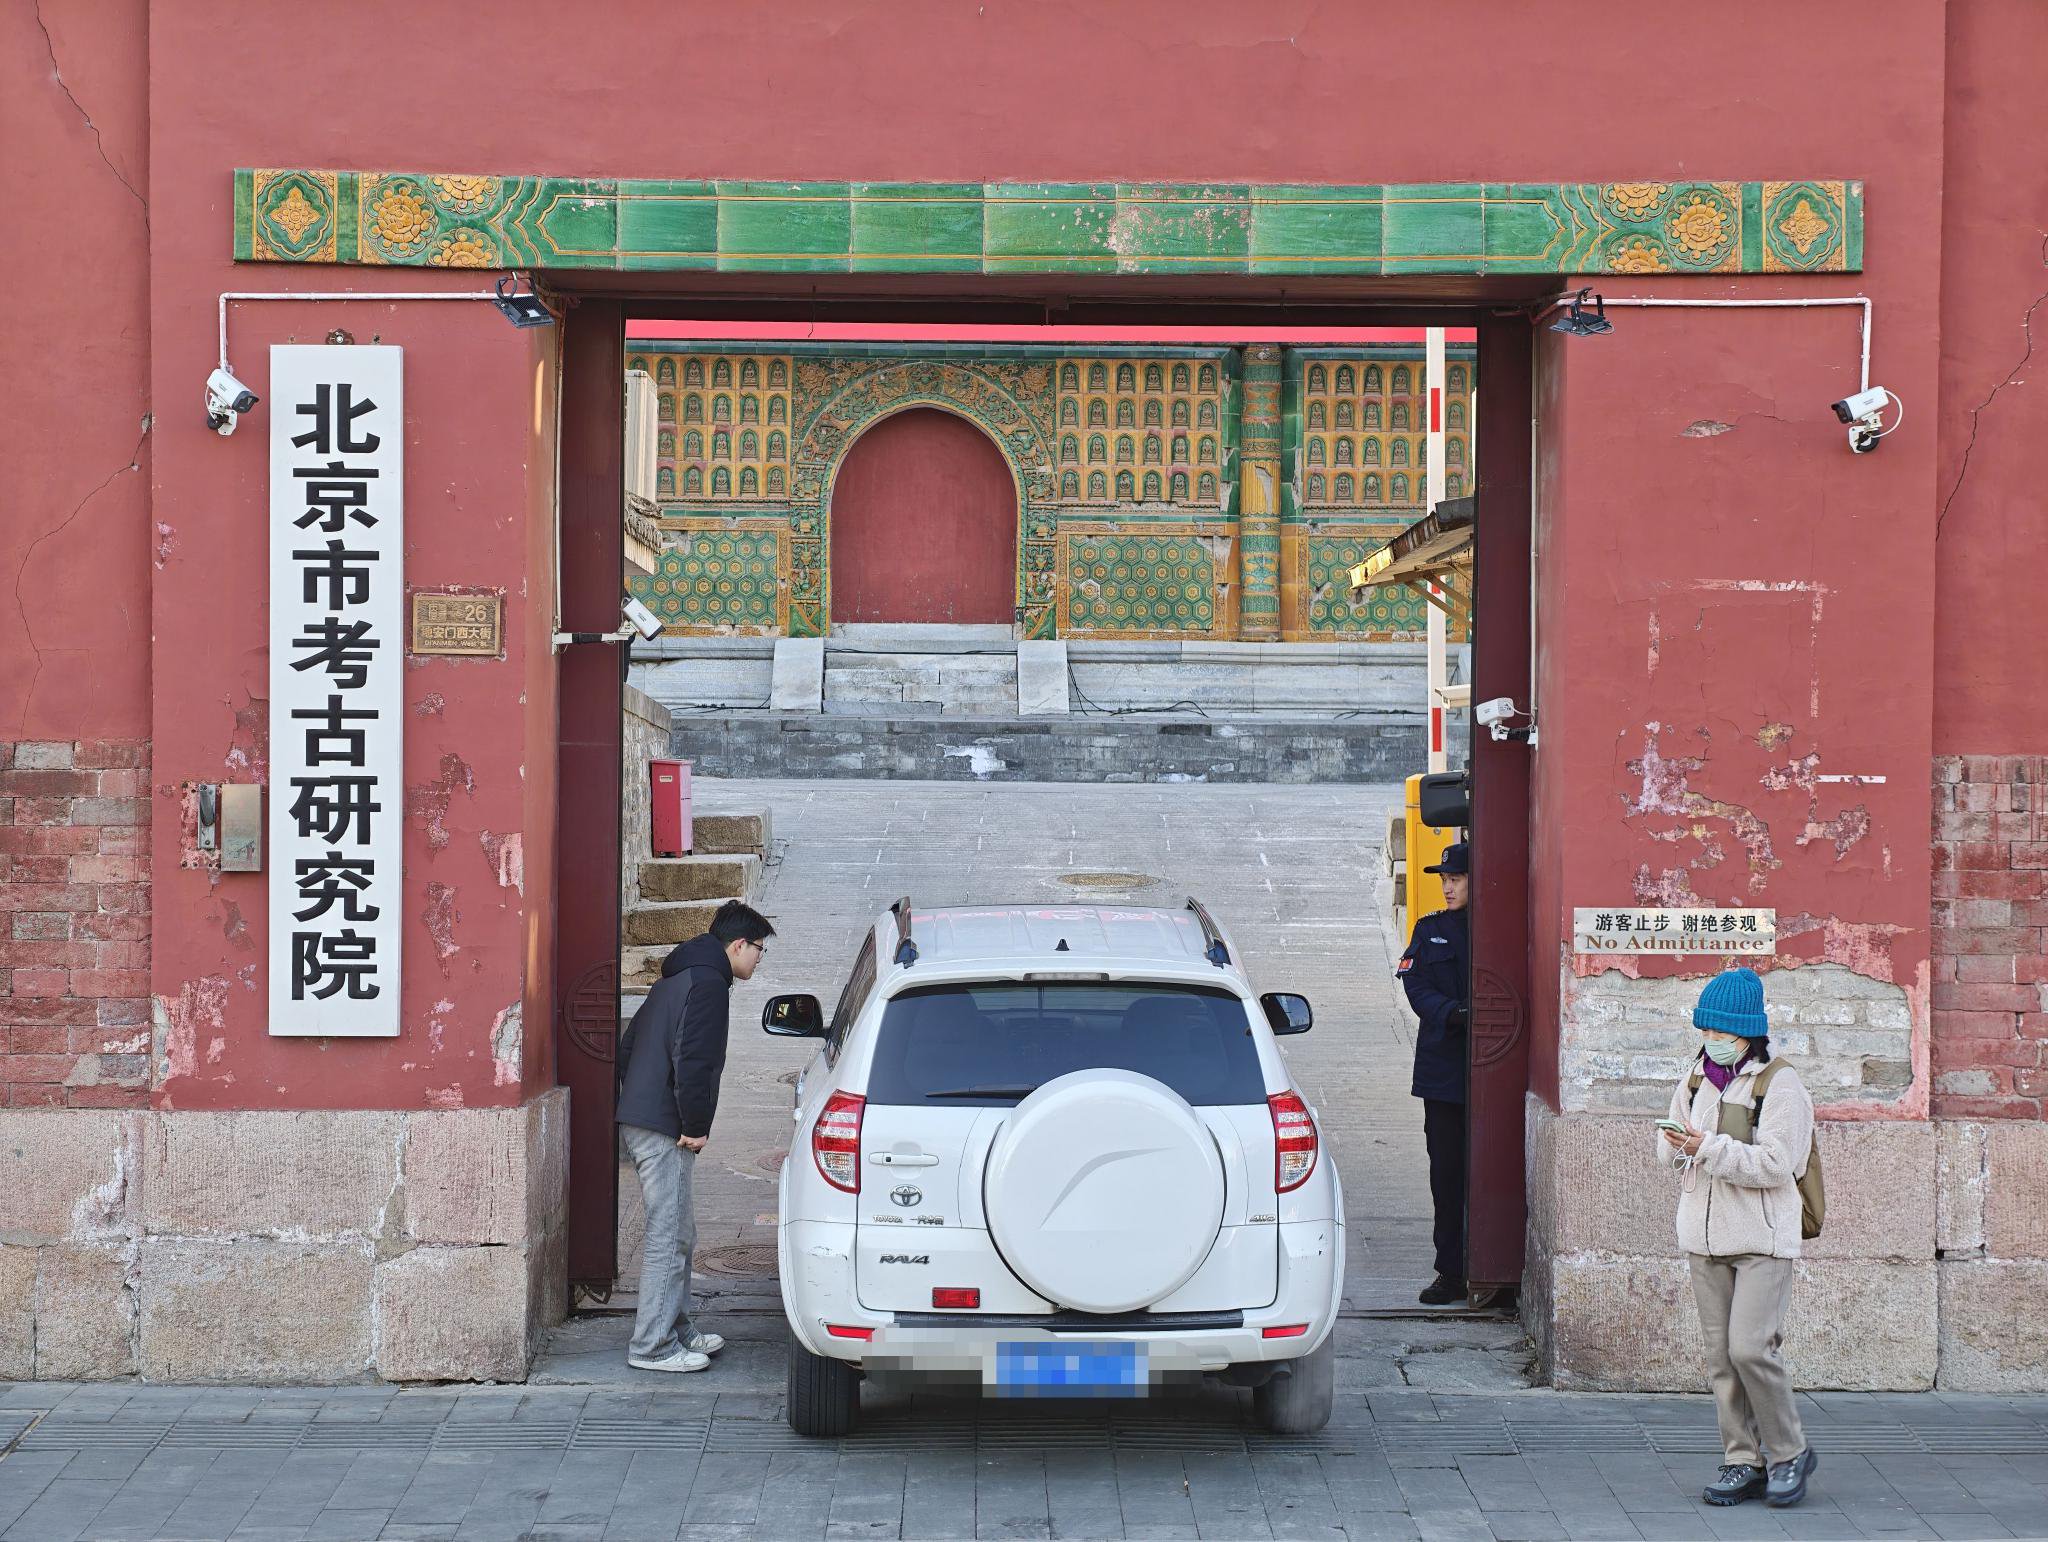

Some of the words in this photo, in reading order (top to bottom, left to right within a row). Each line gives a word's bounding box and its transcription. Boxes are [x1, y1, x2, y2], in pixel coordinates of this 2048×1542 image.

[464, 604, 487, 622] 26
[421, 626, 492, 640] 地安门西大街
[289, 383, 382, 1001] 北京市考古研究院
[1595, 914, 1670, 932] 游客止步
[1682, 914, 1757, 932] 谢绝参观
[1585, 934, 1618, 950] No
[1625, 934, 1765, 951] Admittance
[873, 1214, 903, 1224] TOYOTA
[879, 1254, 930, 1265] RAV4
